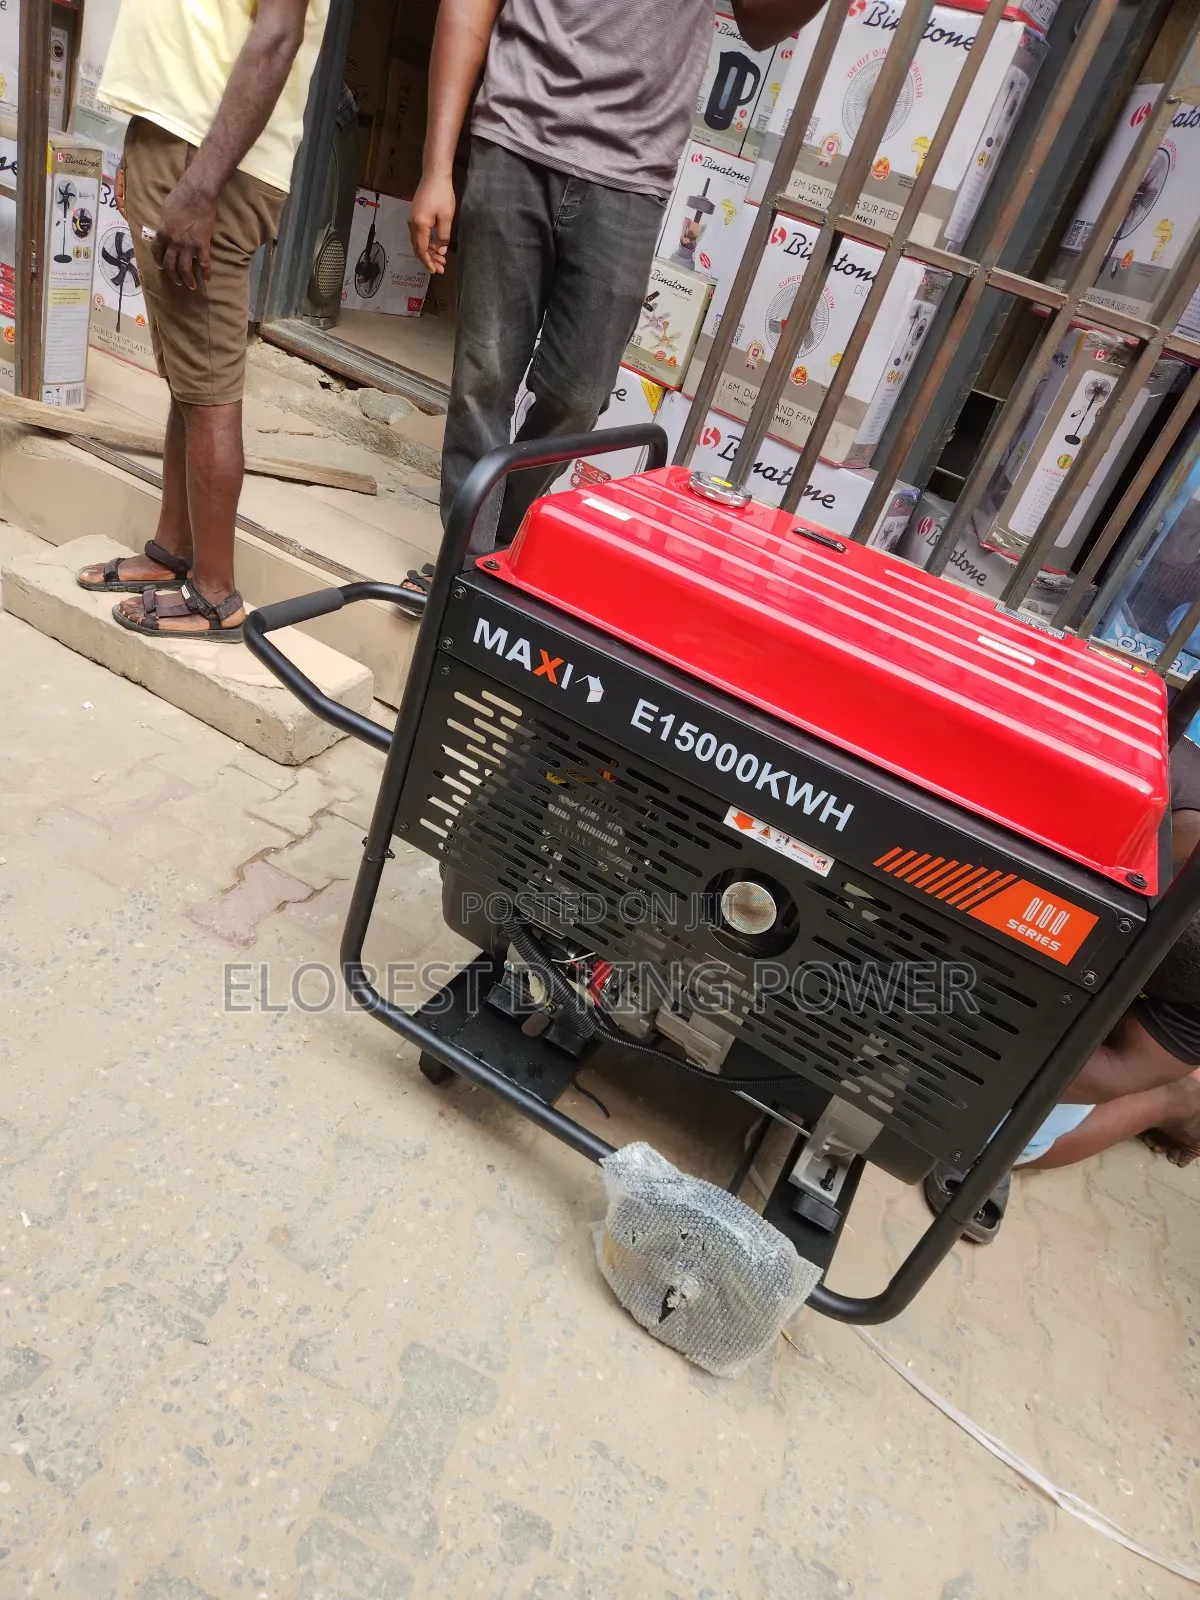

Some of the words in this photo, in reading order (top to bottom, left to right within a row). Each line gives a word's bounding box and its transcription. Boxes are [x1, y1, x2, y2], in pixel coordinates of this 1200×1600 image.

[65, 153, 100, 168] Binatone
[701, 156, 751, 183] Binatone
[862, 200, 878, 215] SUR
[879, 207, 900, 221] PIED
[651, 265, 694, 296] Binatone
[472, 617, 574, 690] MAXI
[630, 698, 855, 832] E15000KWH
[1006, 918, 1062, 952] SERIES
